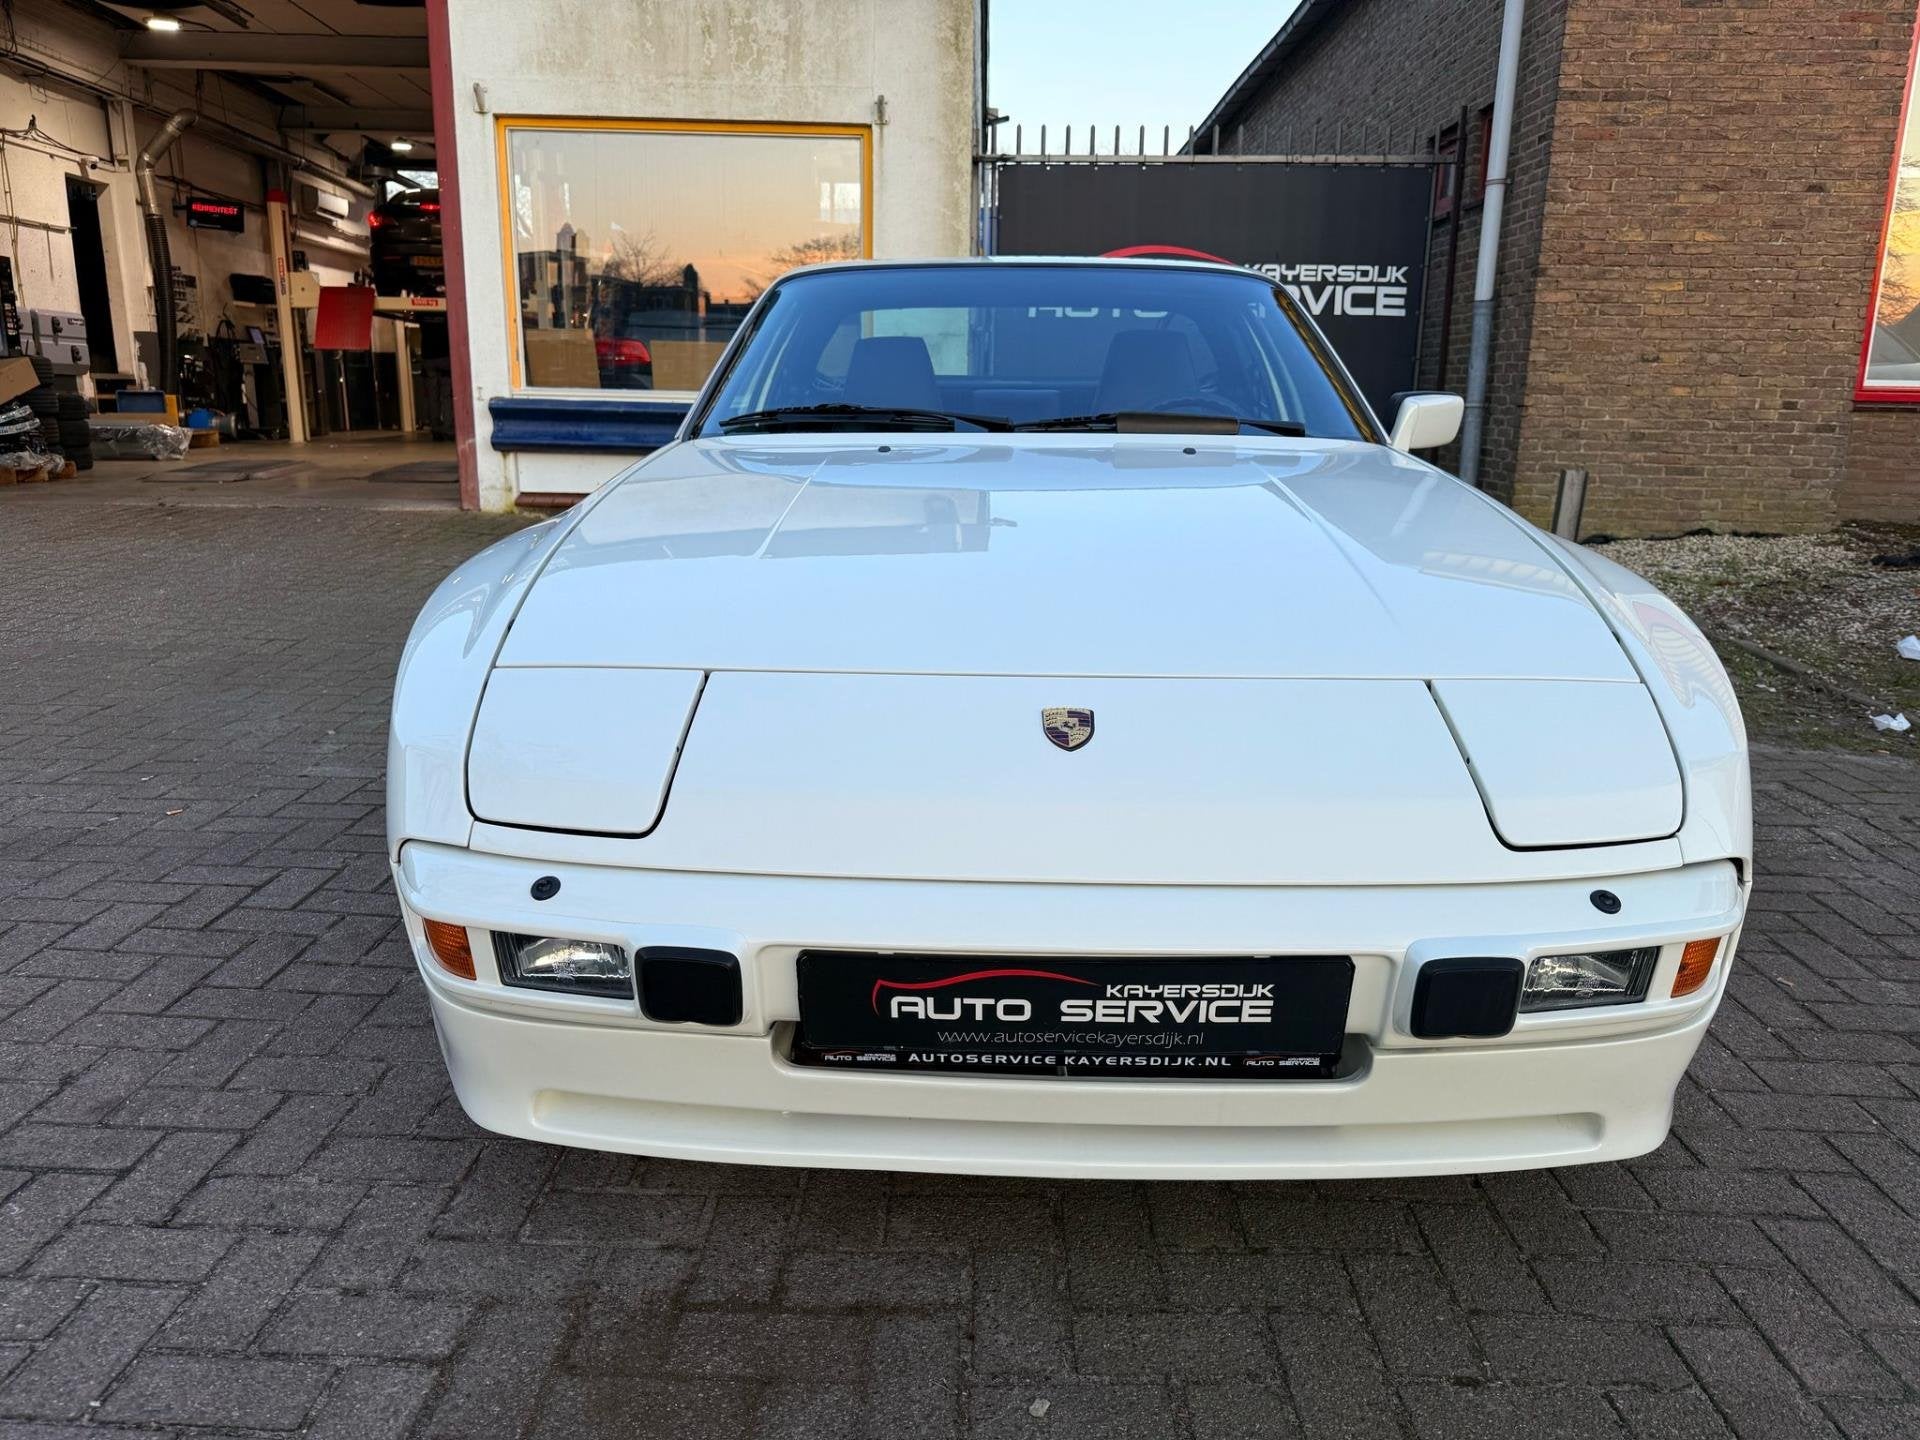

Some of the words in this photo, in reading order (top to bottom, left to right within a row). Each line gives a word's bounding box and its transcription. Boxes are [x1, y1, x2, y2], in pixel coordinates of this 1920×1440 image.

[1106, 984, 1274, 999] KAYERSDIJK
[890, 996, 1032, 1022] AUTO
[1060, 999, 1273, 1024] SERVICE
[937, 1030, 1204, 1049] www.autoservicekayersdijk.nl
[908, 1053, 1056, 1065] AUTOSERVICE
[1064, 1055, 1231, 1067] KAYERSDIJK.NL
